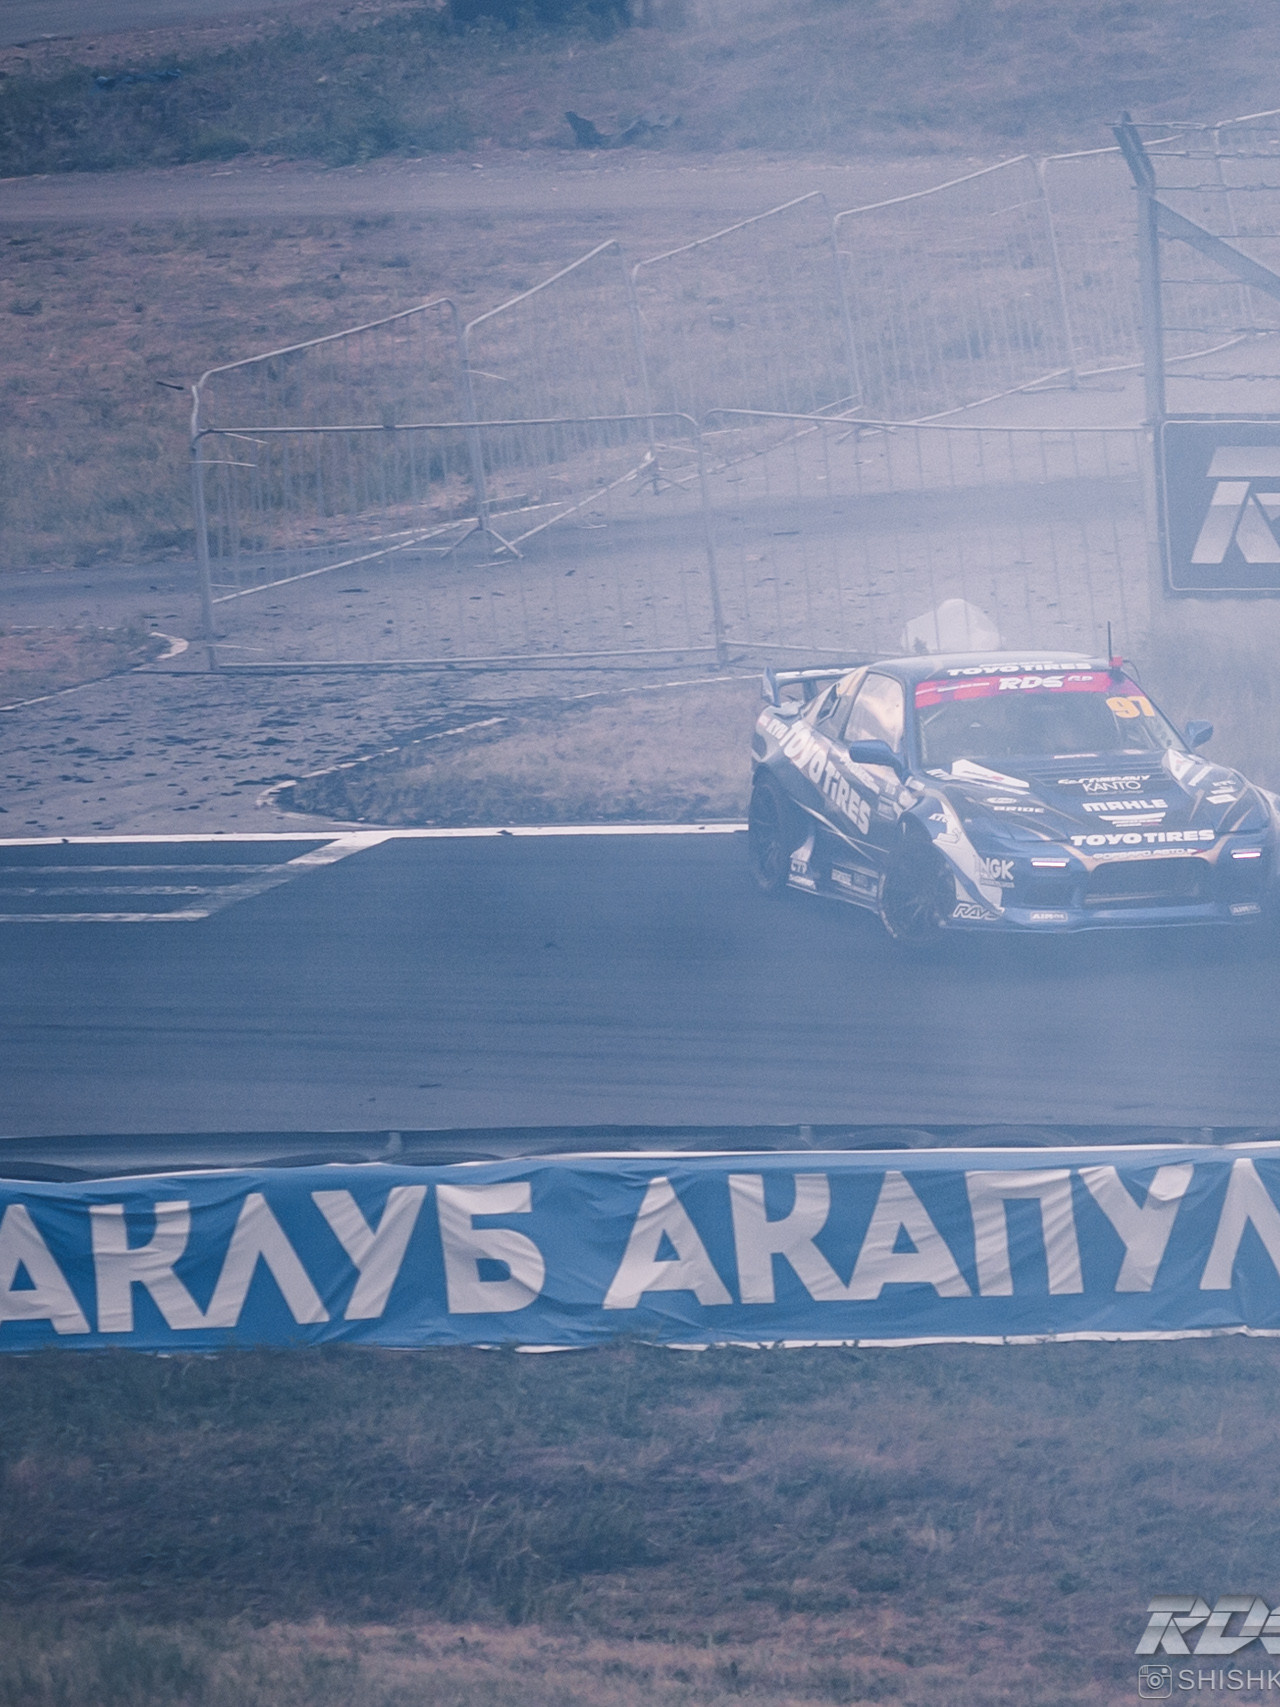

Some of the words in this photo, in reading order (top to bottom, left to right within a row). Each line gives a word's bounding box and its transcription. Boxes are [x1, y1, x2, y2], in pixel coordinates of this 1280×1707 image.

[947, 663, 1024, 676] TOYO
[1026, 662, 1092, 672] TIRES
[999, 675, 1064, 690] RDS
[1106, 696, 1155, 718] 97
[778, 718, 828, 783] TOYO
[822, 761, 871, 835] TIRES
[1082, 781, 1142, 792] KANTO
[1082, 799, 1168, 812] MAHLE
[1070, 832, 1142, 846] TOYO
[1143, 829, 1216, 842] TIRES
[980, 858, 1015, 880] NGK
